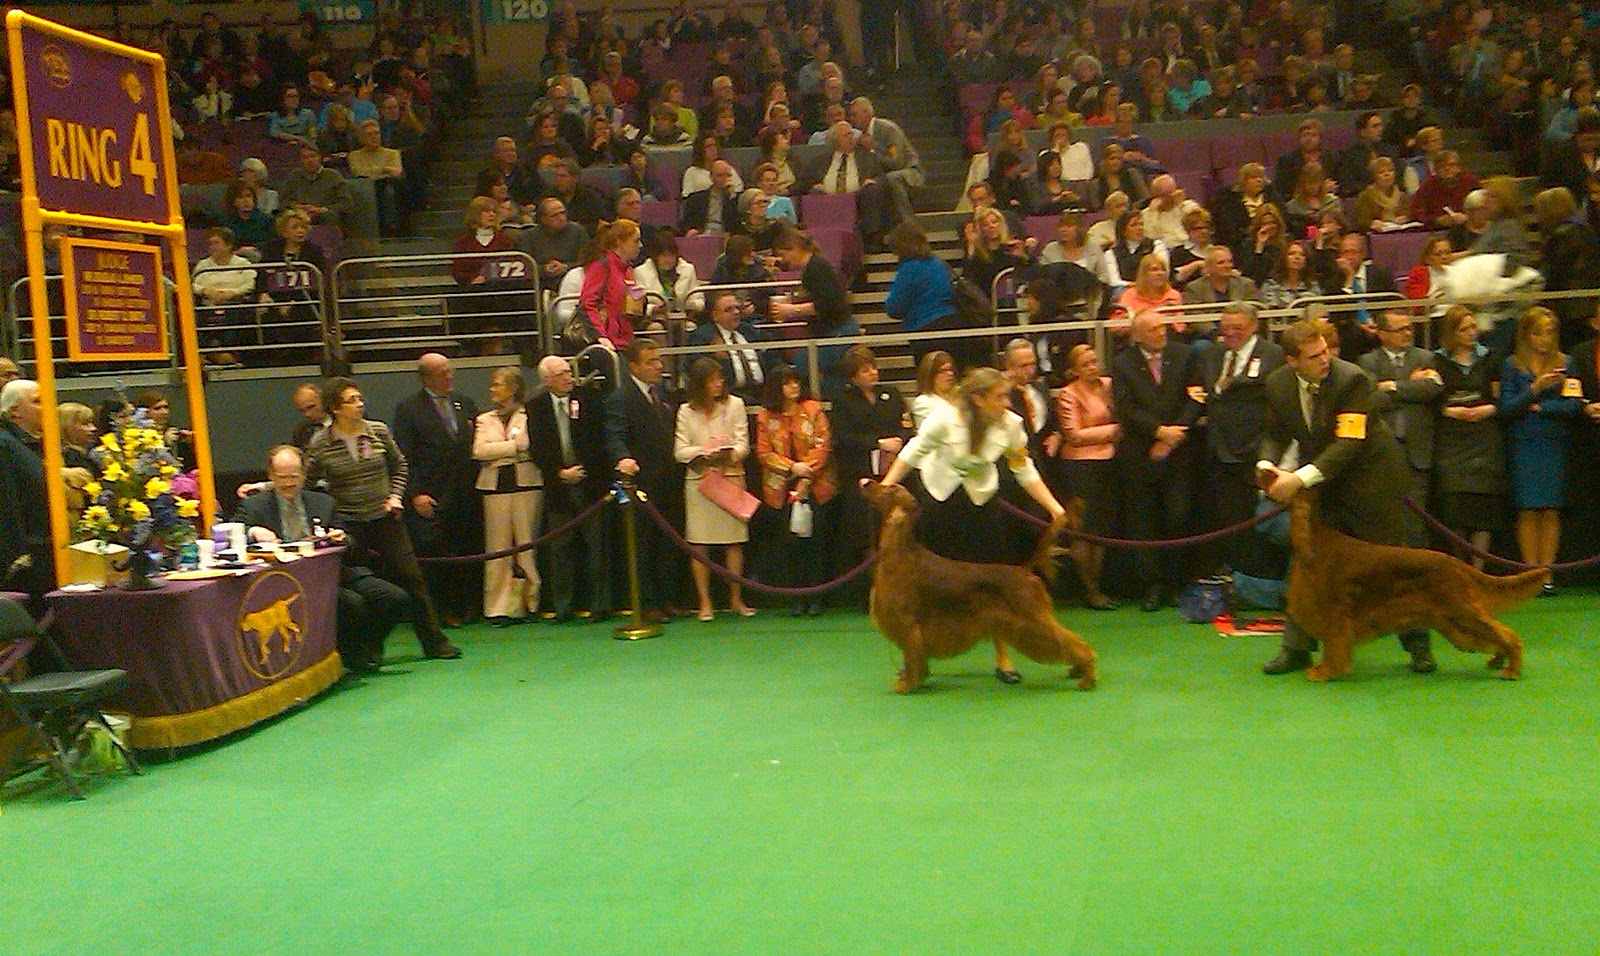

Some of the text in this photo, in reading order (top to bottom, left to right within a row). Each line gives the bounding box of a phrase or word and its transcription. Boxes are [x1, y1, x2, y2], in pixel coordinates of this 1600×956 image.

[502, 0, 548, 19] 120
[46, 112, 158, 196] RING 4
